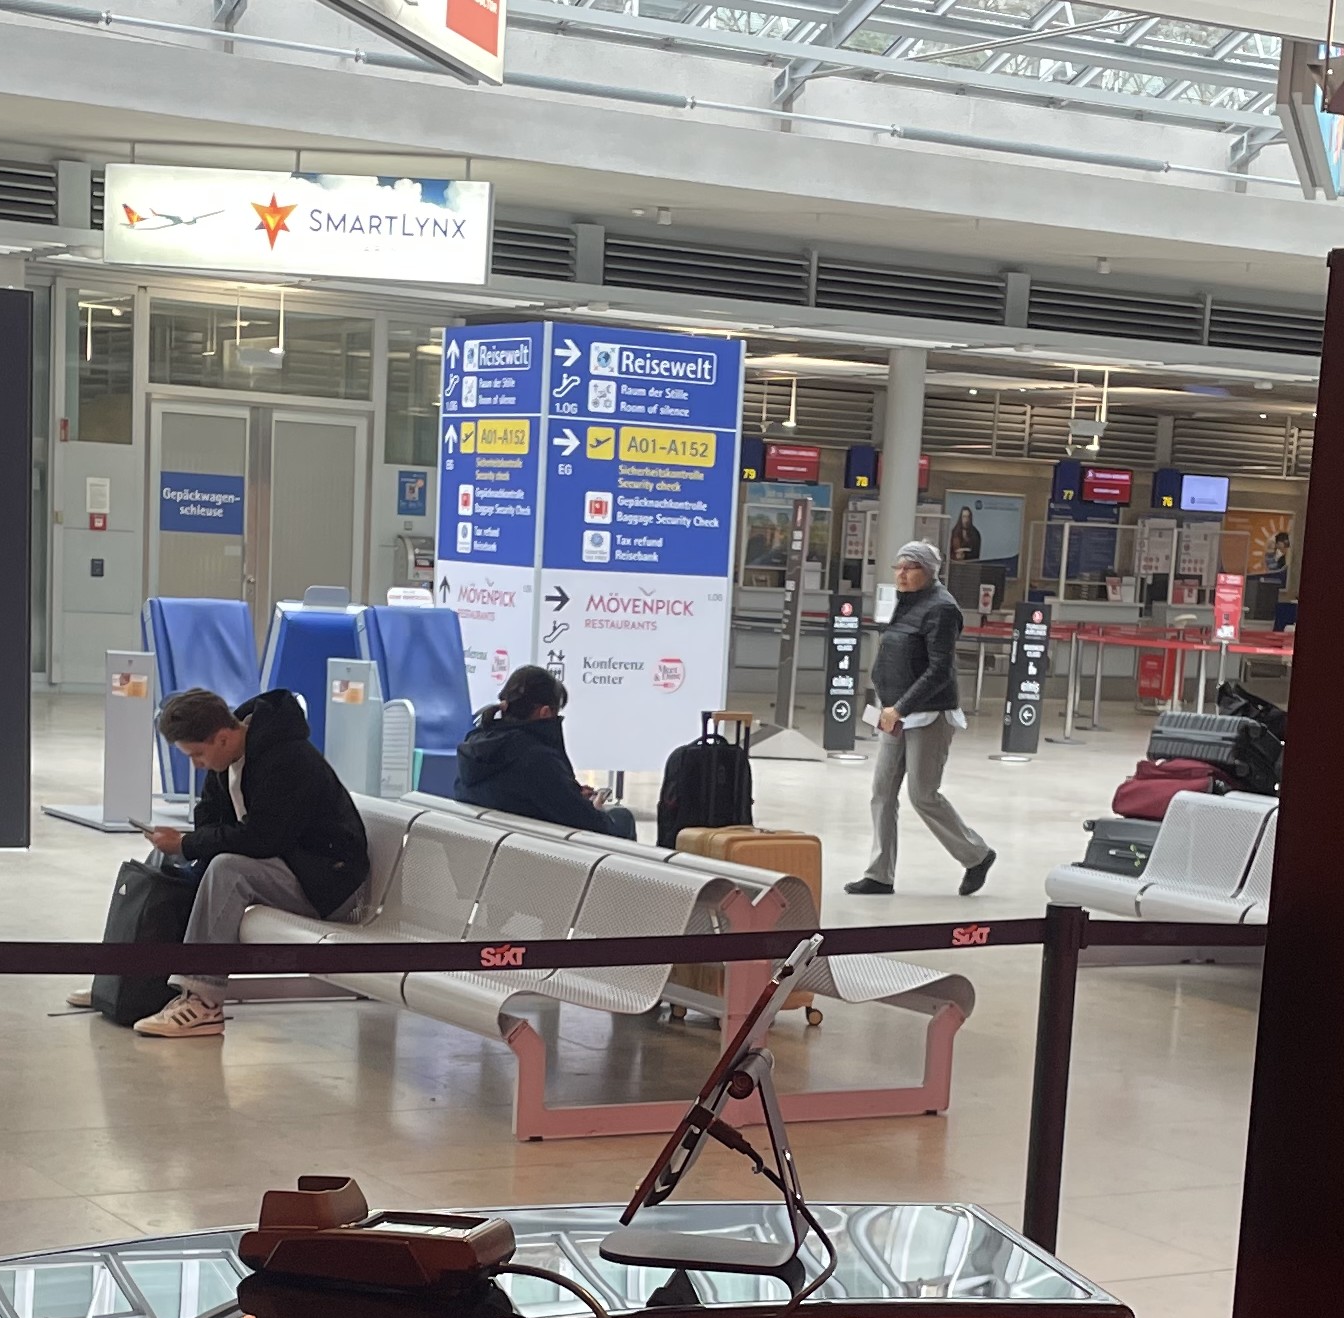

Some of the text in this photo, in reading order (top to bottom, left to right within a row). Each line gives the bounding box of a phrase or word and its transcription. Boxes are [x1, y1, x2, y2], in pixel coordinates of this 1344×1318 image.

[309, 209, 466, 239] SMARTLYNX
[479, 343, 529, 366] Reisewelt
[620, 350, 714, 380] Reisewelt
[620, 383, 690, 400] Raum der Stille
[619, 401, 690, 418] Room of silence
[627, 436, 709, 458] A01-A152
[558, 463, 573, 476] EG
[742, 468, 756, 480] 79
[617, 477, 682, 492] Security check
[179, 504, 224, 517] schleuse
[616, 511, 720, 528] Baggage Security Check
[615, 534, 664, 548] Tax refund
[614, 550, 659, 562] Reisebank
[585, 592, 694, 616] MÖVENPICK
[584, 618, 657, 631] RESTAURANTS
[583, 656, 645, 671] Konferenz
[582, 671, 625, 685] Center
